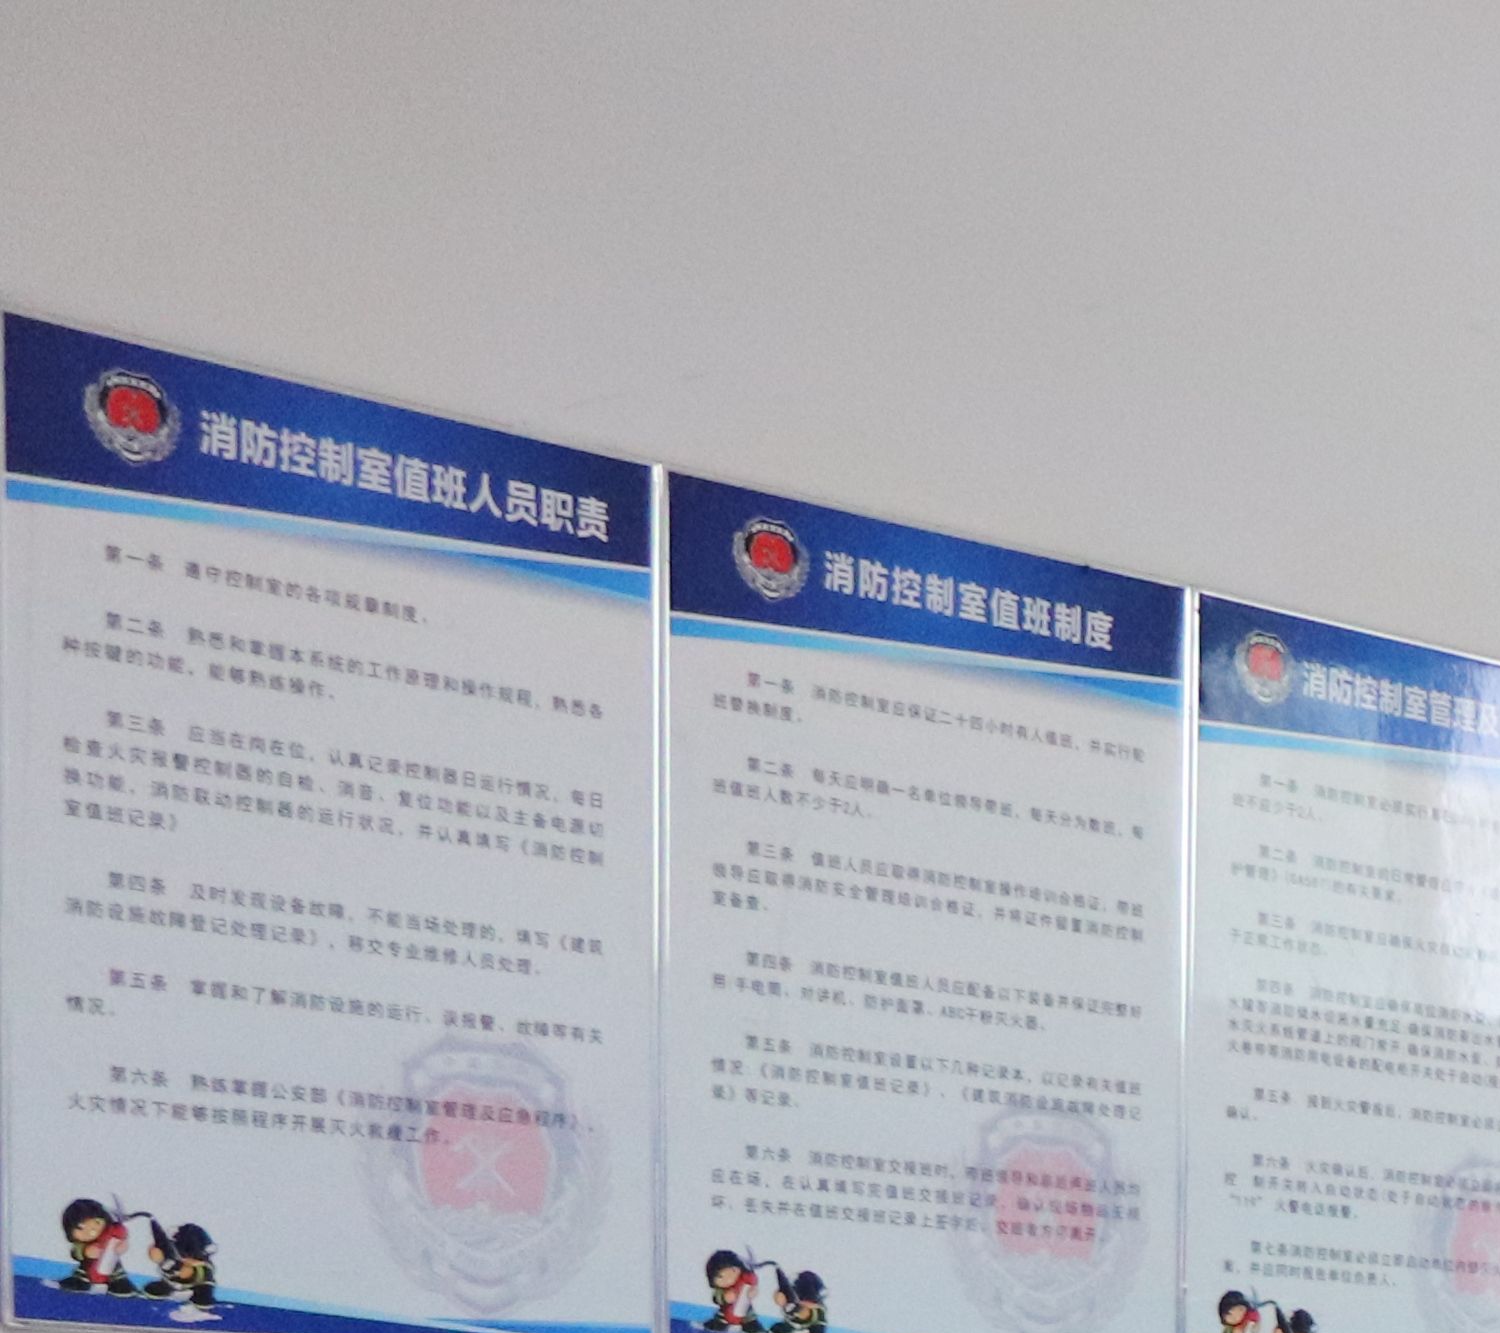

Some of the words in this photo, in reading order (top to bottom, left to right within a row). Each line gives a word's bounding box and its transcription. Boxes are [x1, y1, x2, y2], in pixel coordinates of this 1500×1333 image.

[199, 410, 610, 544] 消防控制室值班人员职责
[104, 543, 165, 575] 第一条
[823, 549, 1115, 652] 消防控制室值班制度
[104, 609, 165, 641] 第二条
[747, 670, 795, 698] 第一条
[105, 708, 166, 738] 第三条
[746, 754, 794, 781] 第二条
[746, 838, 794, 864] 第三条
[107, 870, 168, 899] 第四条
[745, 949, 793, 974] 第四条
[107, 966, 168, 994] 第五条
[64, 992, 117, 1019] 情况。
[744, 1033, 792, 1056] 第五条
[108, 1064, 169, 1091] 第六条
[1253, 1085, 1292, 1106] 第五条
[744, 1142, 792, 1164] 第六条
[1252, 1152, 1290, 1172] 第六条
